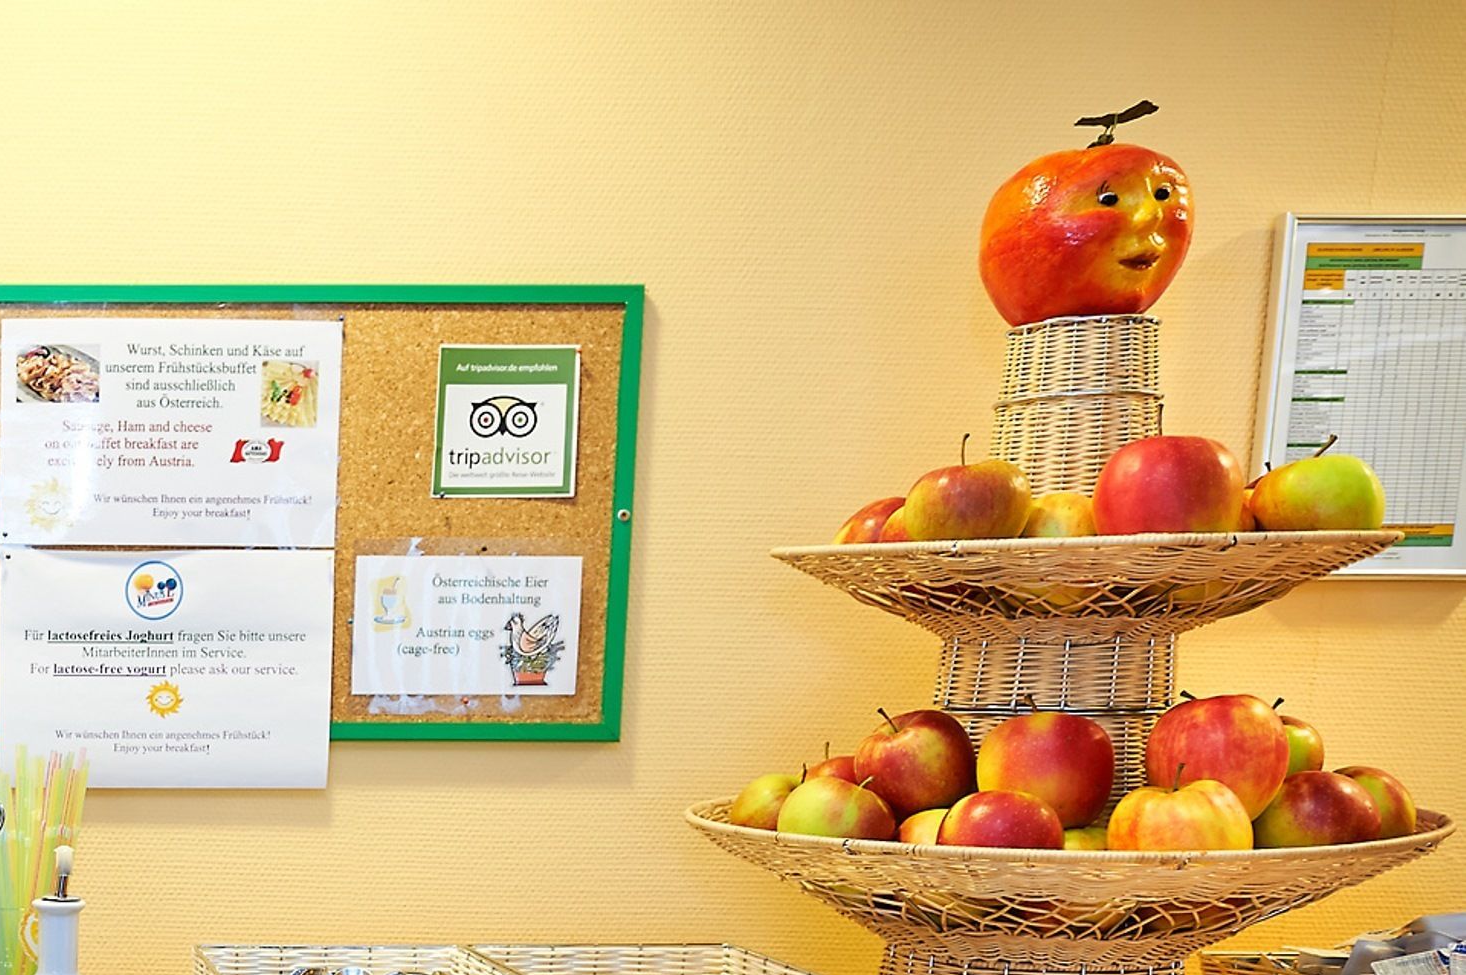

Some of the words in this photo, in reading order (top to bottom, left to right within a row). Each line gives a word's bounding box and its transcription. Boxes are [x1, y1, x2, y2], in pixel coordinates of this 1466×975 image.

[127, 344, 165, 357] Wurst,
[169, 343, 223, 357] Schinken
[227, 344, 248, 357] und
[252, 344, 281, 357] Käse
[284, 345, 305, 357] auf
[105, 363, 154, 374] unserem
[158, 361, 256, 374] Frühstücksbuffet
[126, 379, 150, 391] sind
[153, 379, 236, 391] ausschließlich
[136, 398, 156, 408] aus
[159, 394, 223, 408] Österreich.
[117, 420, 145, 432] Ham
[149, 420, 170, 432] and
[173, 420, 213, 432] cheese
[124, 437, 177, 450] breakfast
[181, 440, 199, 449] are
[118, 456, 145, 467] from
[149, 456, 195, 467] Austria.
[449, 447, 551, 469] tripadvisor
[113, 494, 158, 504] wünschen
[161, 494, 187, 504] Ihnen
[189, 495, 203, 504] ein
[205, 495, 262, 506] angenehmes
[153, 508, 179, 519] Enjoy
[182, 509, 203, 519] your
[205, 507, 251, 520] breakfast!
[432, 574, 521, 588] Österreichische
[525, 575, 549, 588] Eier
[438, 596, 457, 605] aus
[461, 593, 542, 607] Bodenhaltung
[24, 629, 44, 641] Für
[47, 629, 122, 642] lactosefreies
[125, 629, 174, 644] Joghurt
[177, 630, 214, 644] fragen
[217, 630, 235, 642] Sie
[238, 630, 265, 642] bitte
[268, 632, 306, 642] unsere
[416, 626, 465, 638] Austrian
[468, 629, 494, 641] eggs
[82, 646, 178, 658] MitarbeiterInnen
[182, 647, 197, 658] im
[200, 646, 247, 659] Service.
[397, 643, 460, 657] (cage-free)
[30, 663, 50, 674] For
[53, 663, 123, 675] lactose-free
[126, 664, 166, 677] yogurt
[170, 663, 206, 677] please
[209, 663, 228, 675] ask
[231, 666, 251, 675] our
[254, 664, 299, 675] service.
[55, 730, 72, 740] Wir
[75, 730, 119, 740] wünschen
[122, 730, 147, 740] Ihnen
[149, 730, 163, 740] ein
[165, 731, 220, 742] angenehmes
[222, 730, 271, 740] Frühstück!
[113, 743, 140, 755] Enjoy
[142, 745, 163, 755] your
[165, 743, 211, 756] breakfast!
